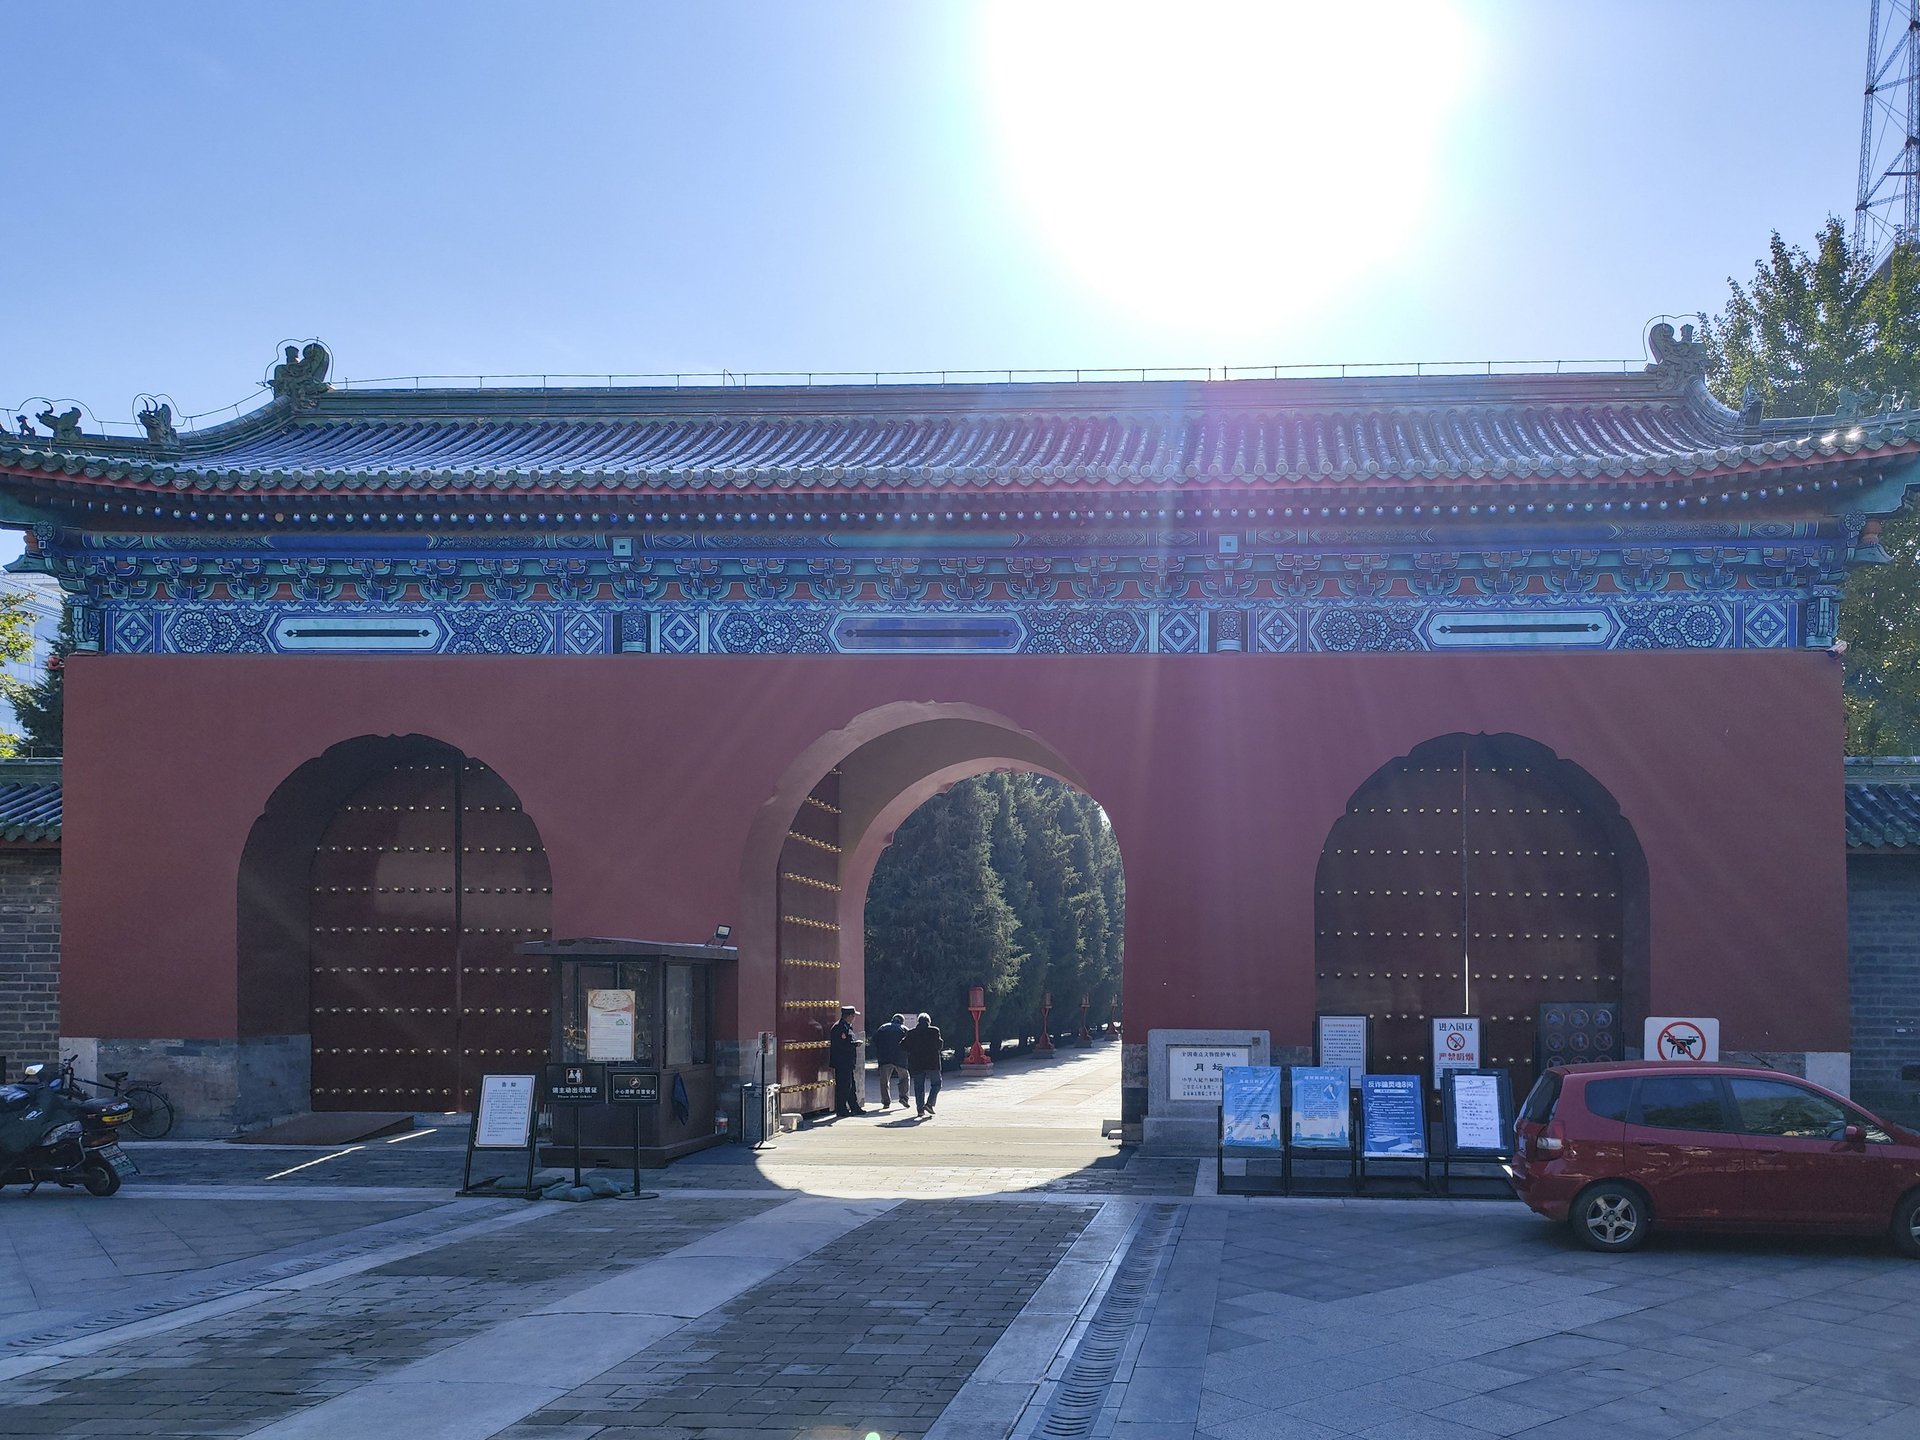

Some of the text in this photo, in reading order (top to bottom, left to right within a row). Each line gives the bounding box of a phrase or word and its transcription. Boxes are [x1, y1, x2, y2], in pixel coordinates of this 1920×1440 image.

[1439, 1023, 1473, 1031] 进入园区
[1438, 1052, 1474, 1061] 严禁吸烟
[1194, 1063, 1223, 1071] 月坛
[552, 1086, 598, 1094] 请主动出示票证
